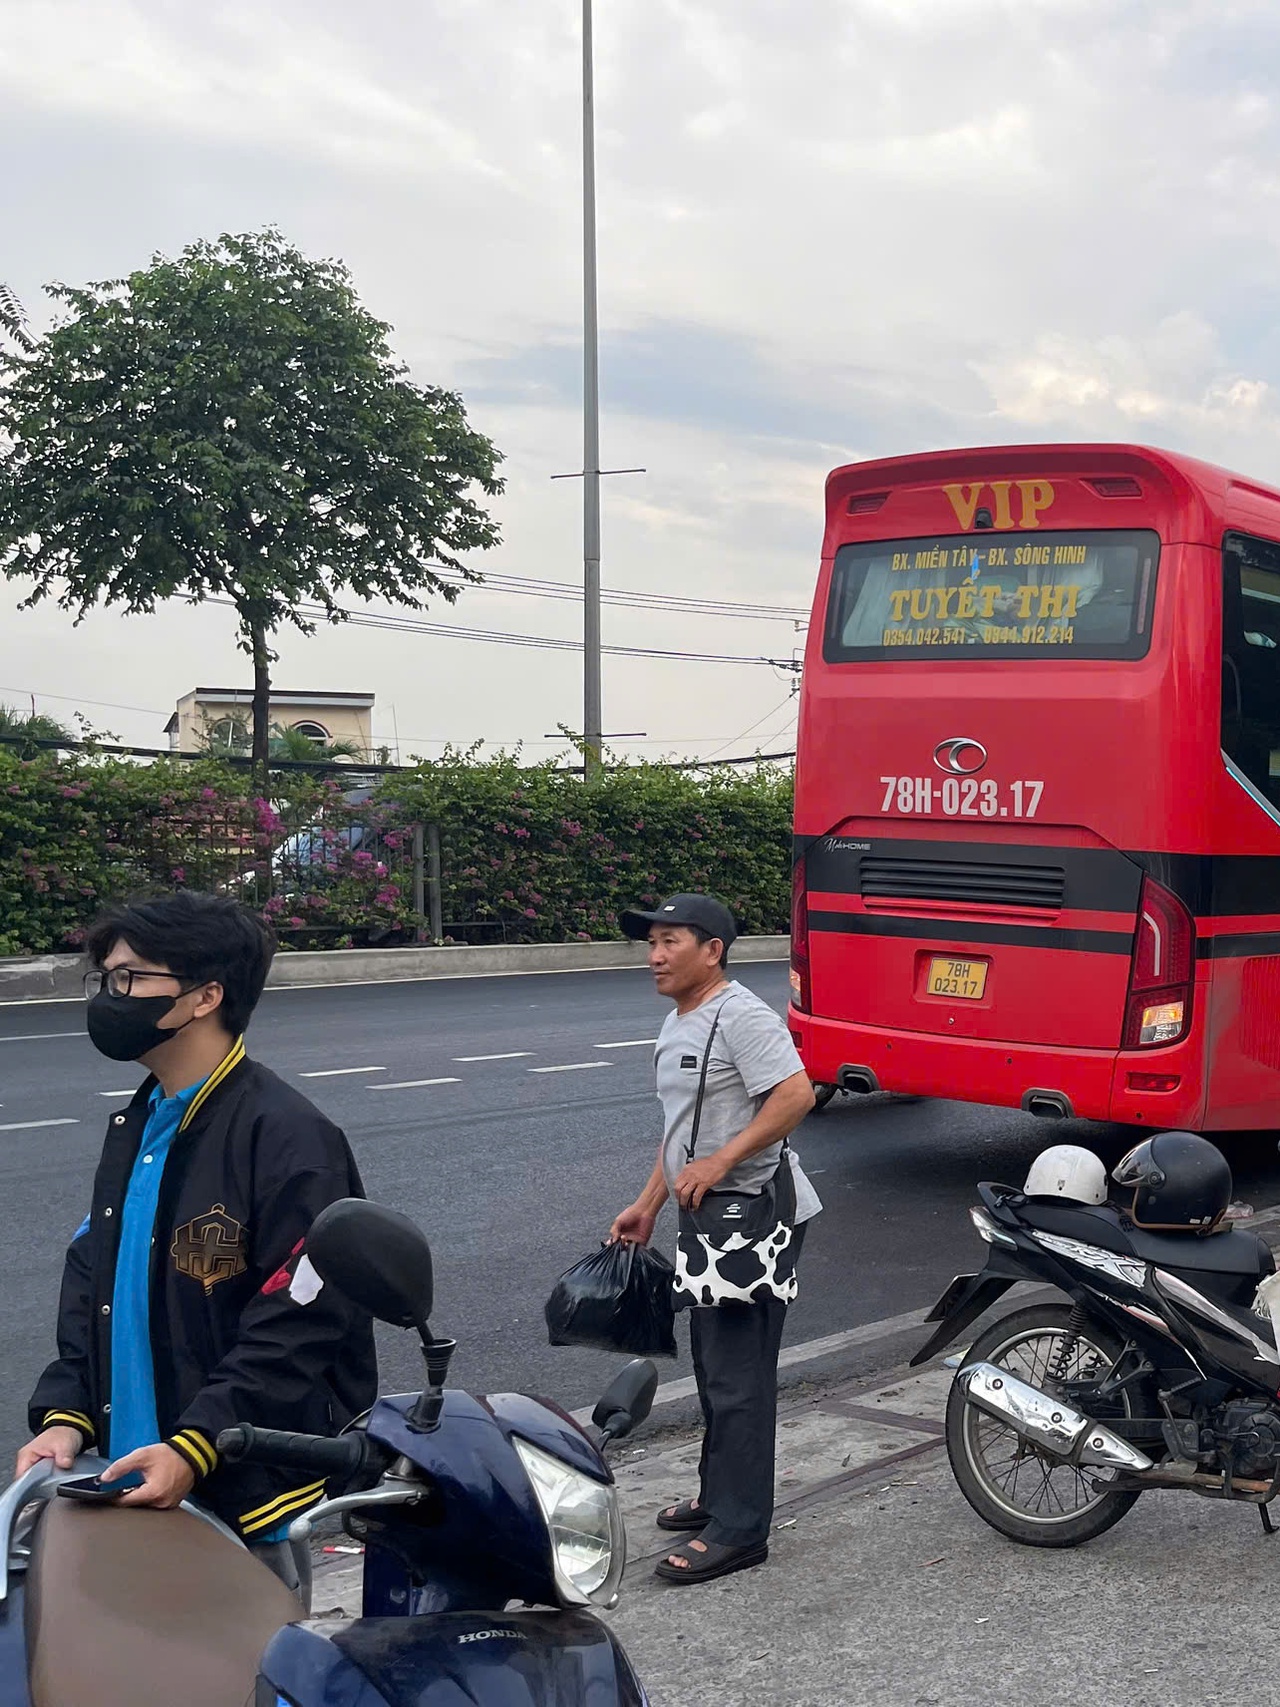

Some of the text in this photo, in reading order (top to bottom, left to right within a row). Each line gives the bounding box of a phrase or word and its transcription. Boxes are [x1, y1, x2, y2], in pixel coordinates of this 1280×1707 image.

[943, 479, 1056, 531] VIP
[892, 553, 910, 571] BX.
[915, 544, 948, 569] MIỀN
[1014, 543, 1050, 565] SÔNG
[1054, 546, 1086, 565] HINH
[889, 569, 1081, 621] TUYẾT THI
[879, 776, 1044, 818] 78H-023.17
[947, 962, 971, 978] 78H
[934, 977, 978, 995] 023.17
[458, 1629, 528, 1643] HONDA
